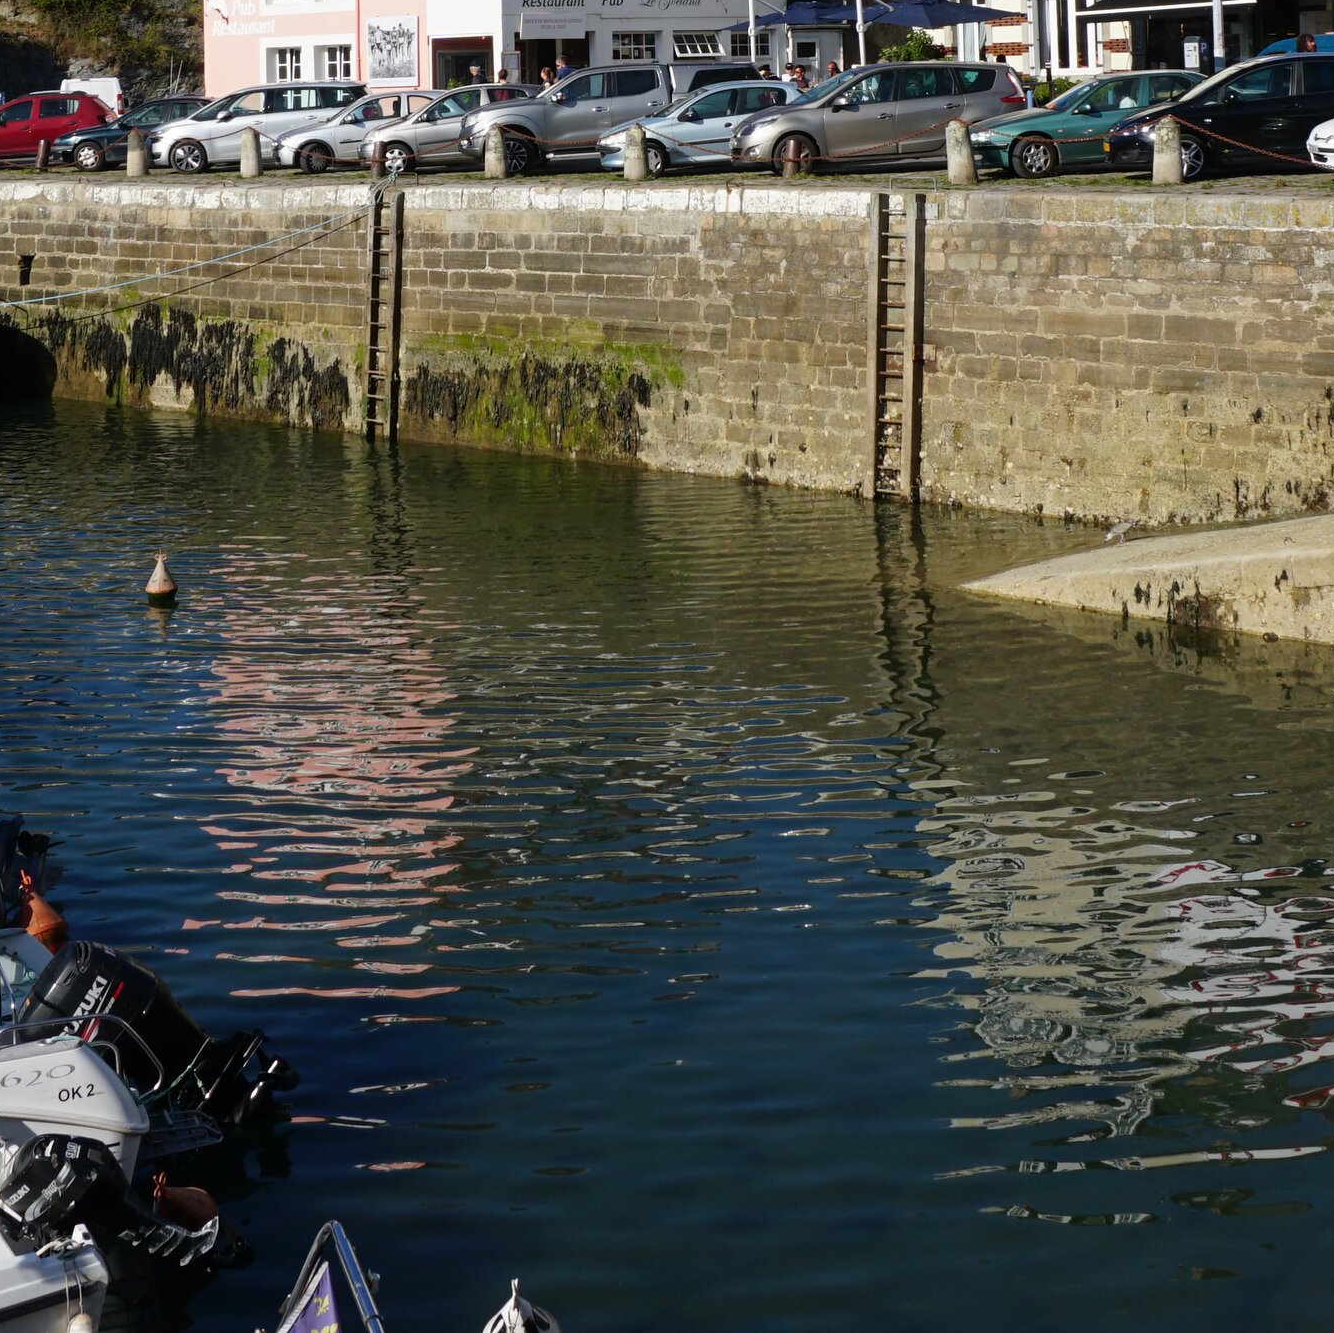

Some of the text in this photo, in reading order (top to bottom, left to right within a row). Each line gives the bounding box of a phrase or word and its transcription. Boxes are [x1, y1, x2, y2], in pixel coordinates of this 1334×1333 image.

[232, 0, 256, 17] Pub
[212, 18, 277, 37] Restaurant
[58, 974, 109, 1037] UZUKI
[0, 1063, 76, 1088] 620
[58, 1082, 96, 1103] OK 2
